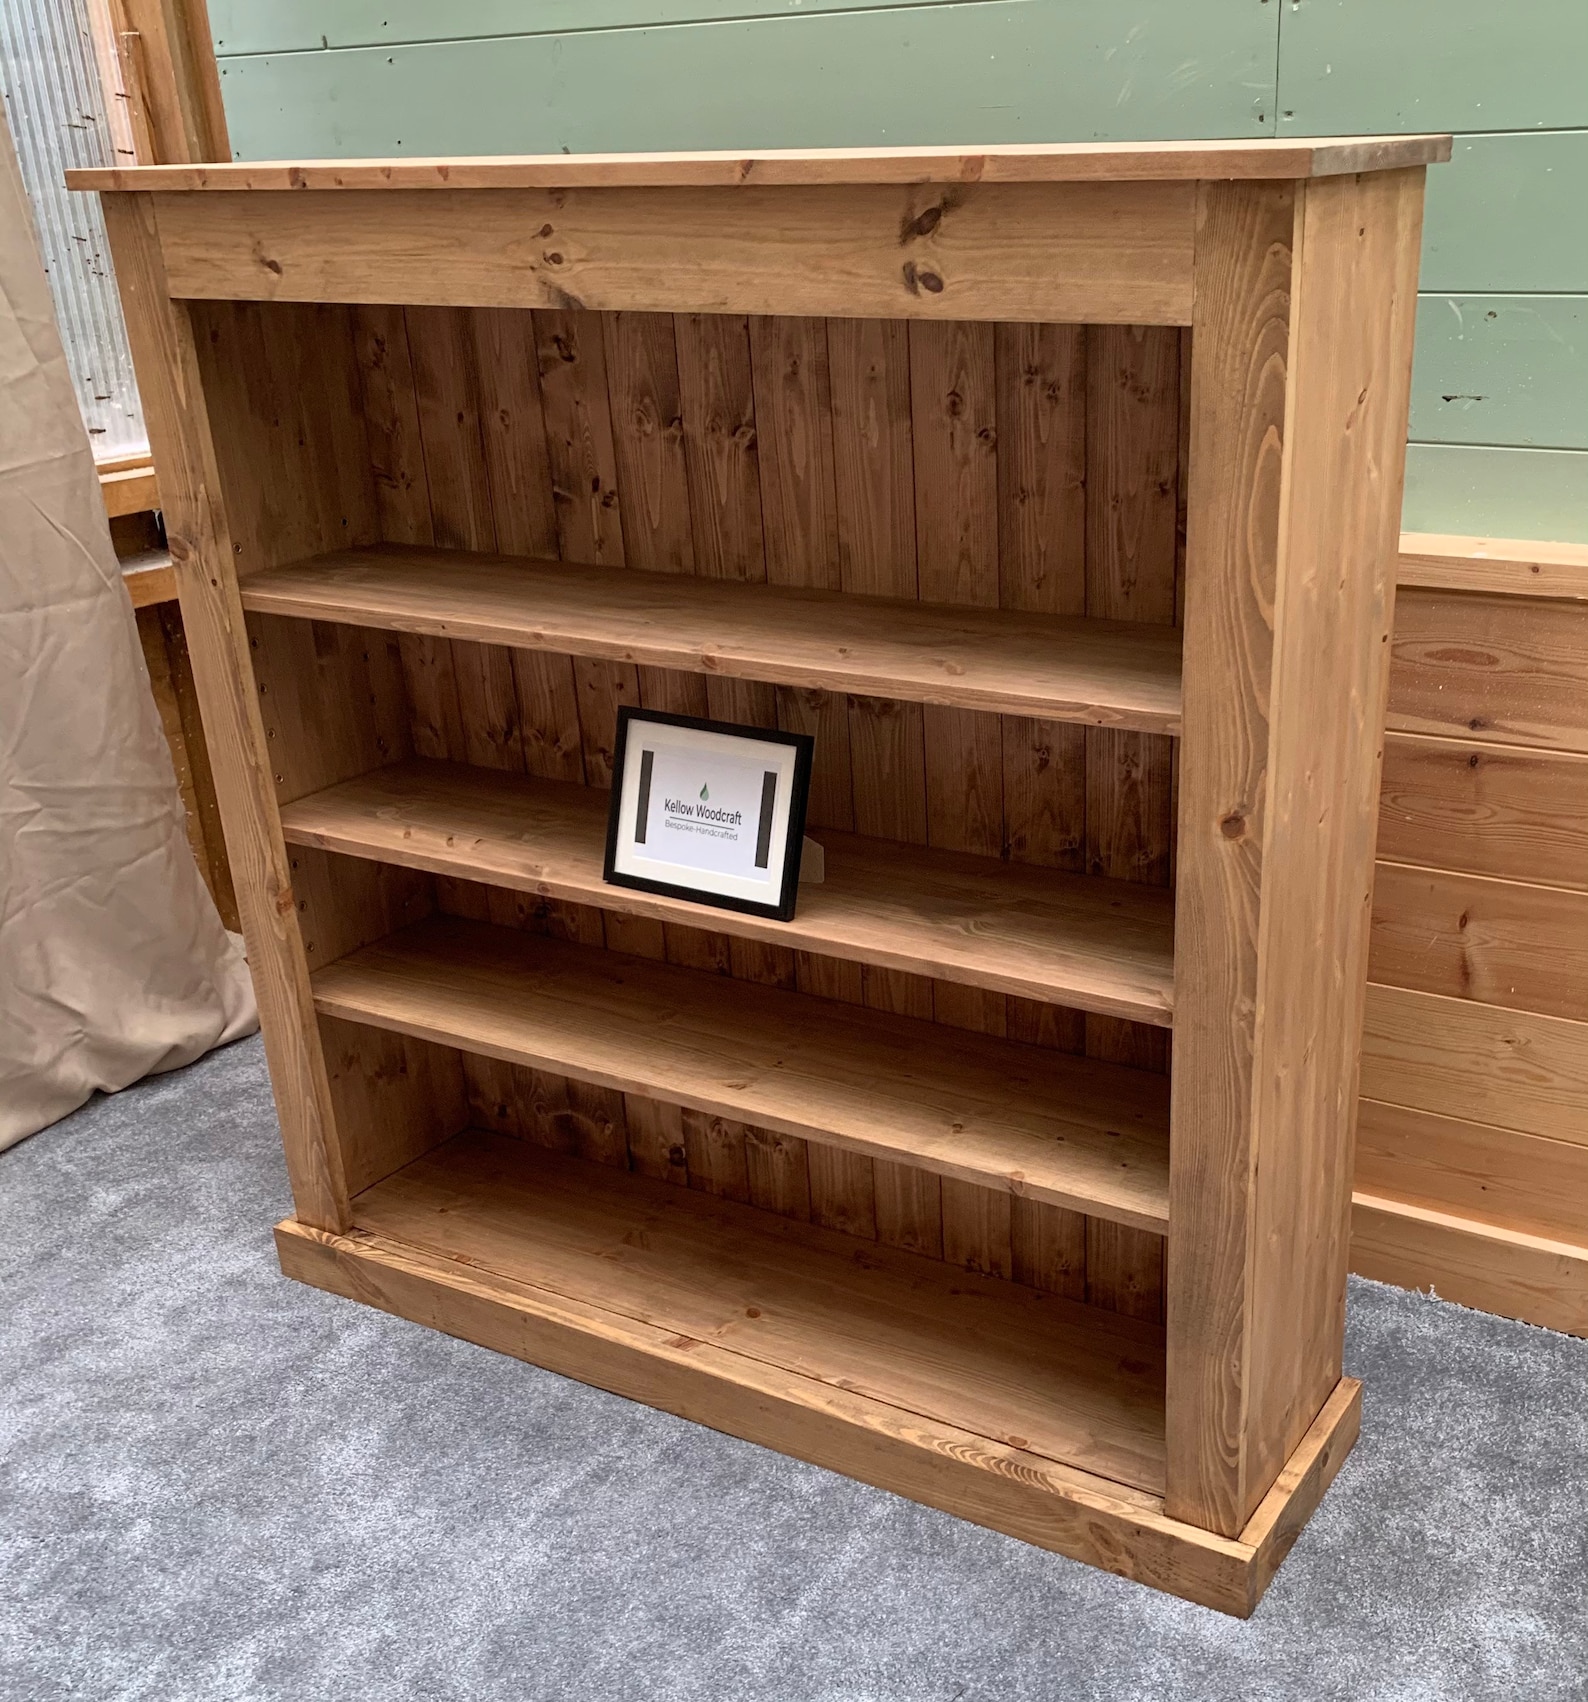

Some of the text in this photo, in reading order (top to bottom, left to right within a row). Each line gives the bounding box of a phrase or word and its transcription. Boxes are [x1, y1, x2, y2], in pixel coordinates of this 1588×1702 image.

[664, 798, 742, 825] Kellow Woodcraft
[665, 819, 738, 841] Bespoke-Handcrafted
